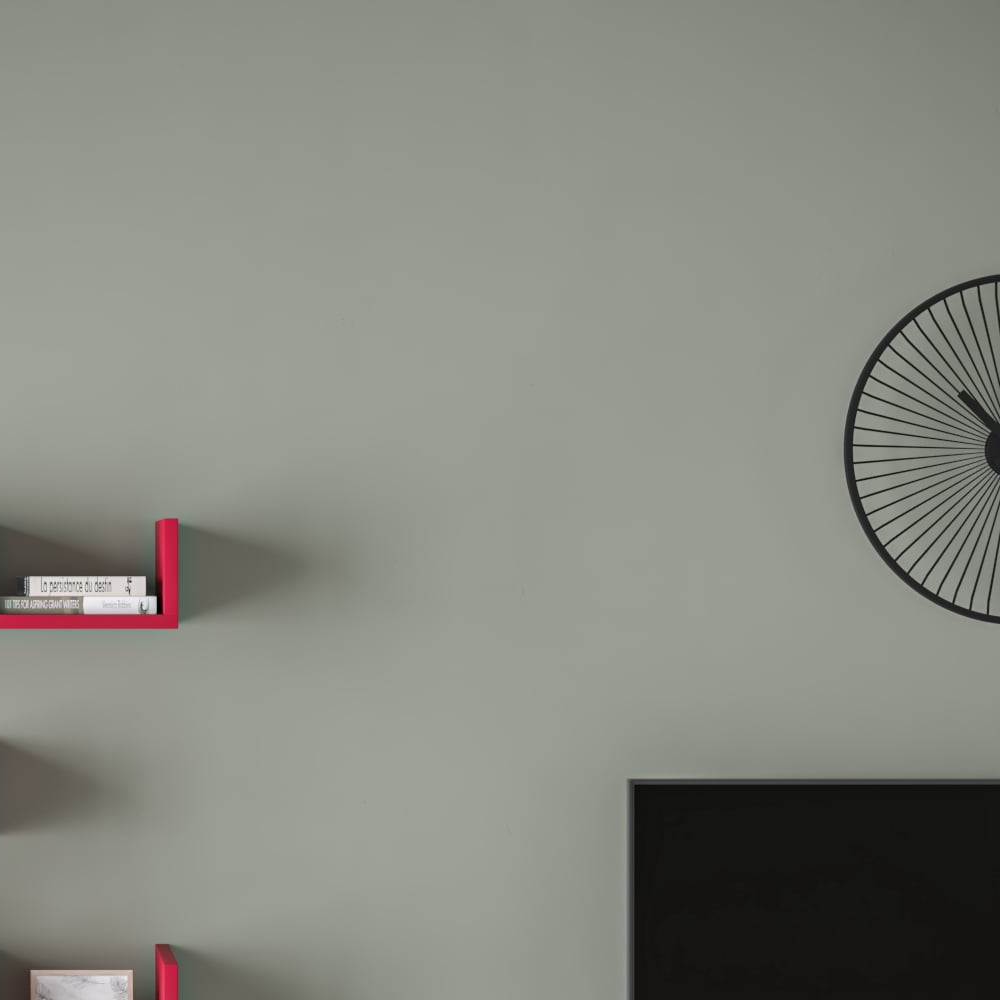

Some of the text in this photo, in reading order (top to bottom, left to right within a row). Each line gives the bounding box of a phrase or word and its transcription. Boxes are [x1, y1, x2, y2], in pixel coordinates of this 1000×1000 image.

[41, 577, 47, 592] La
[85, 577, 93, 593] du
[95, 577, 112, 593] destin
